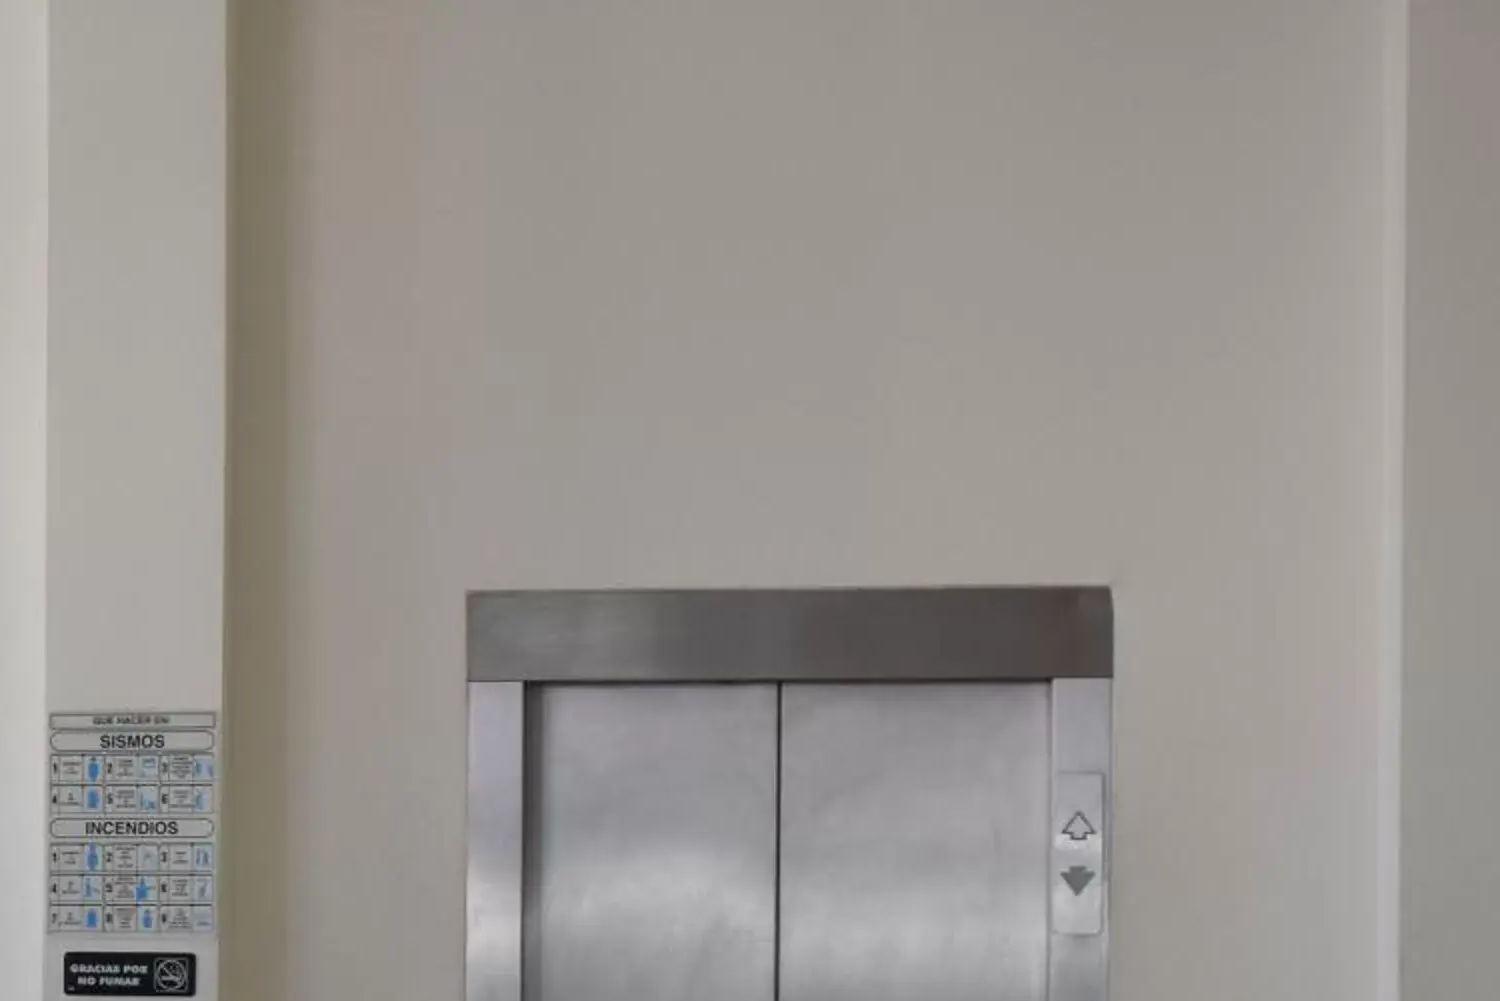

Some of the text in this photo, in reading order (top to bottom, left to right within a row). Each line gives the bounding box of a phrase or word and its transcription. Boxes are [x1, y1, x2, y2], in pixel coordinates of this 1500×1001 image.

[100, 735, 165, 748] SISMOS
[85, 821, 179, 835] INCENDIOS
[70, 963, 148, 975] GRACIAS POR
[77, 976, 141, 986] NO FUMAR
